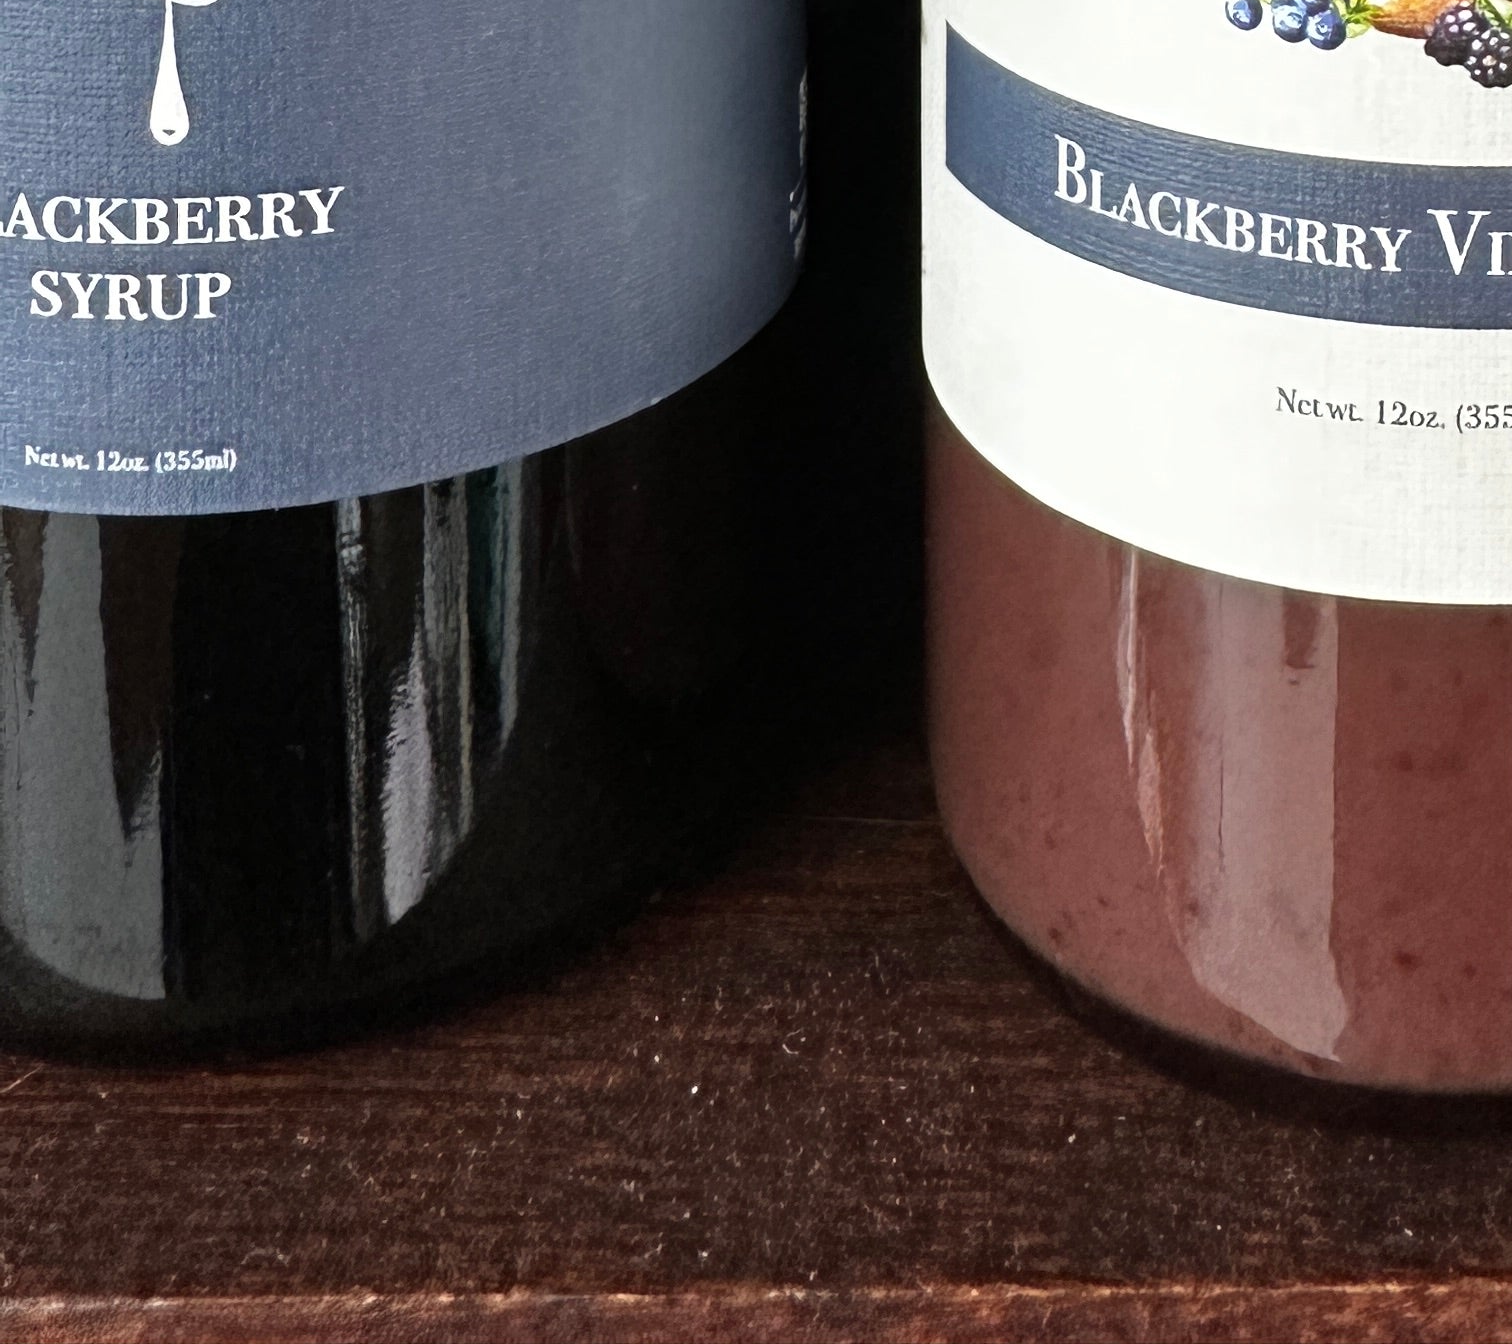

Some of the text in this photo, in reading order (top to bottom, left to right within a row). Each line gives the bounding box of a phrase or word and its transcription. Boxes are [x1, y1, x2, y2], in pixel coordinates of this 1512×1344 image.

[29, 269, 233, 322] SYRUP
[1377, 399, 1446, 430] 12oz.
[155, 448, 238, 475] (355ml)
